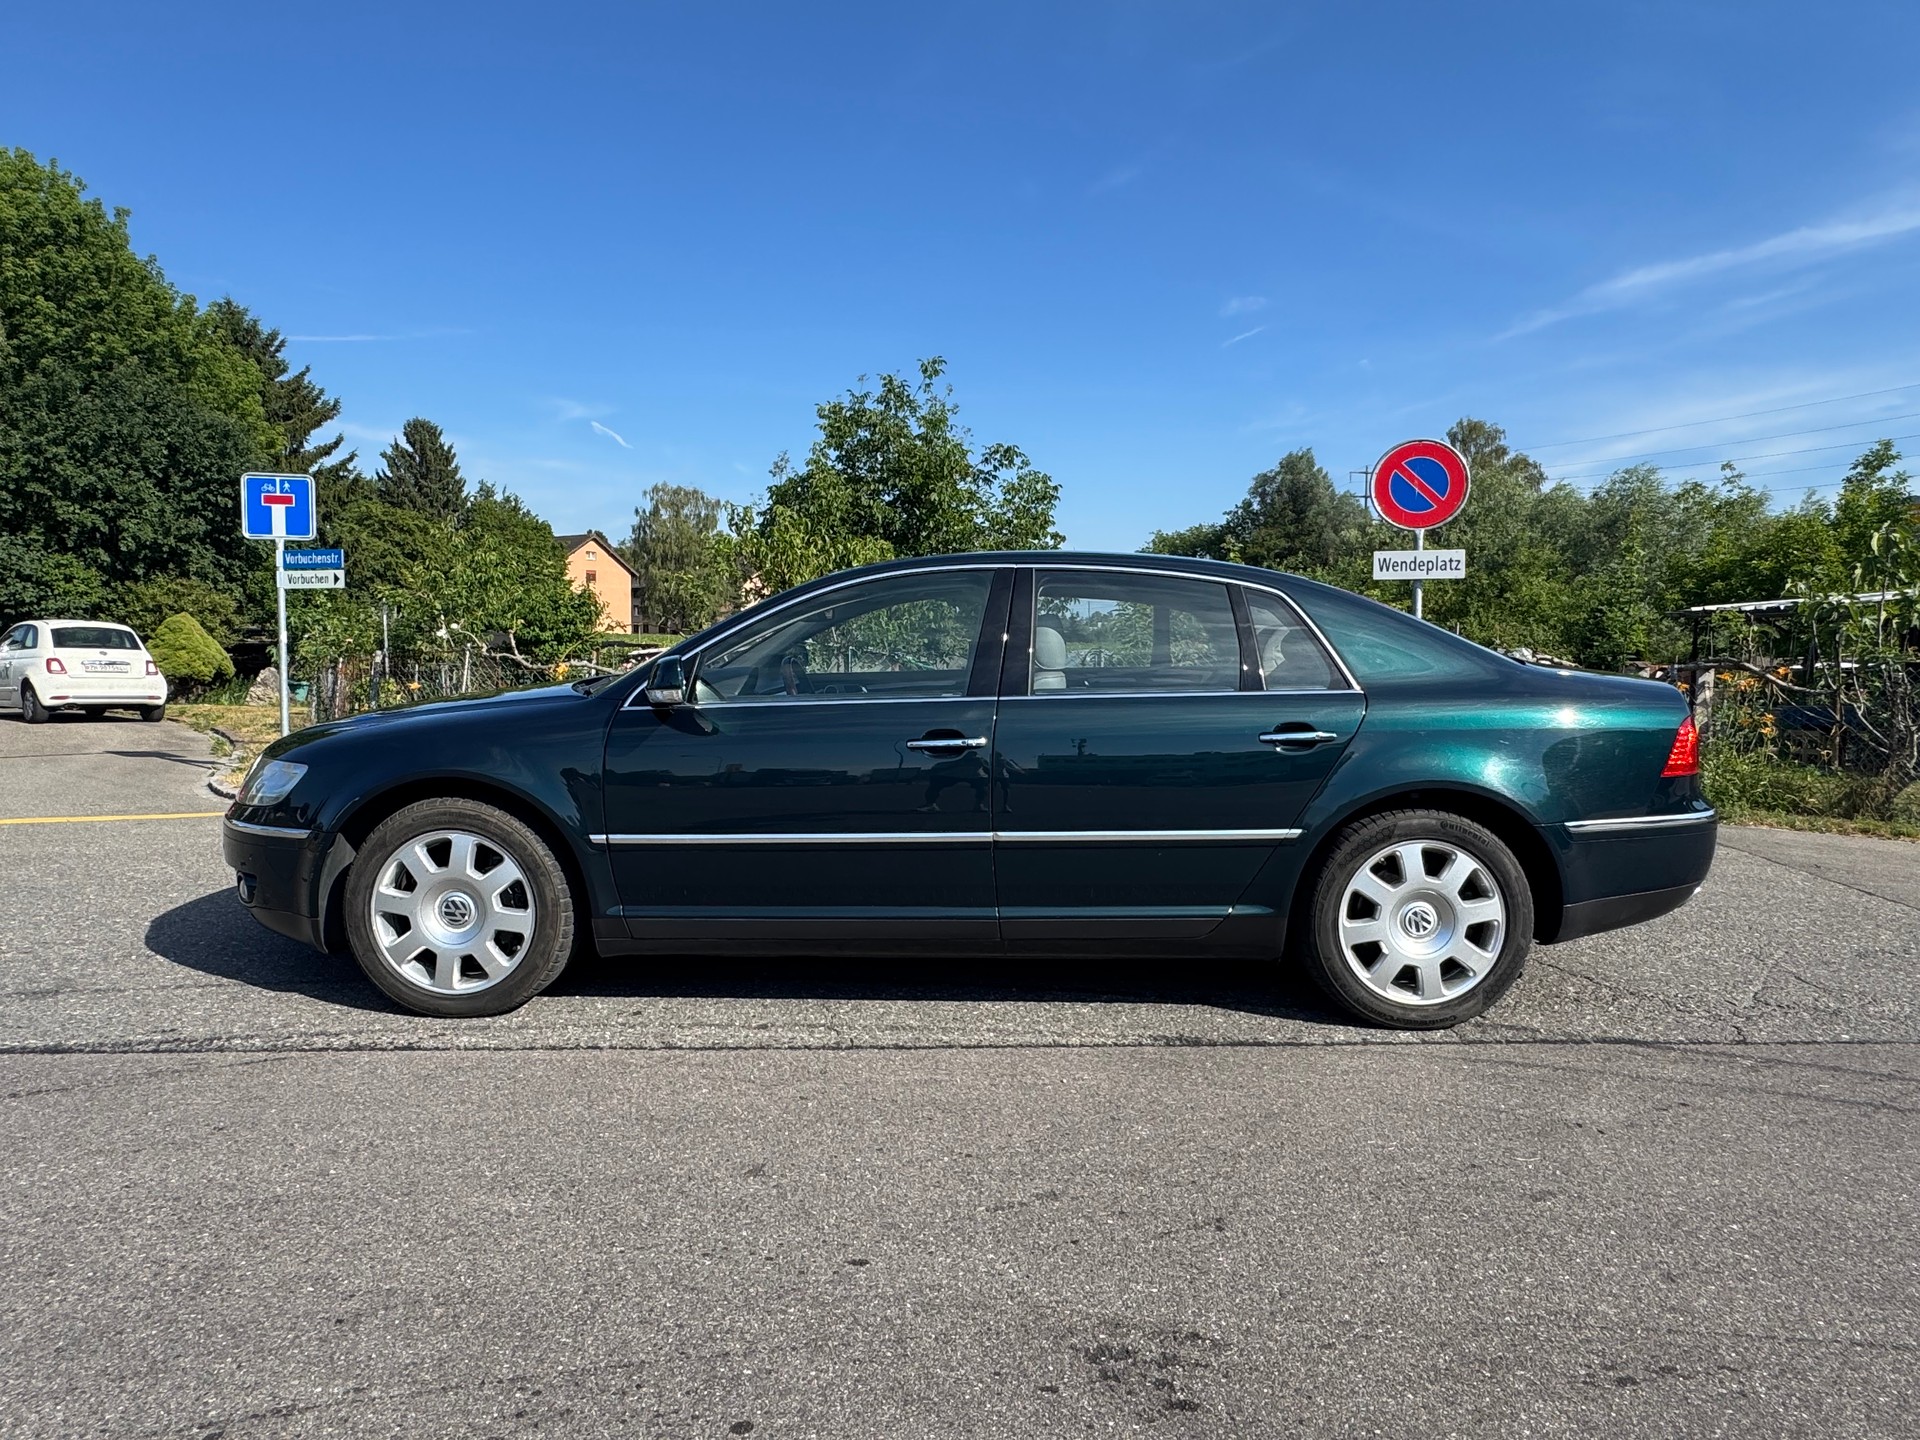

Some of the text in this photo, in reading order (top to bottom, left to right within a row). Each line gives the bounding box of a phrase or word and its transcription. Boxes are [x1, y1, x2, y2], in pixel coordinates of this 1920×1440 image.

[285, 552, 340, 564] Vorbuchenstr.
[1378, 555, 1461, 575] Wendeplatz
[287, 573, 329, 585] Vorbuchen
